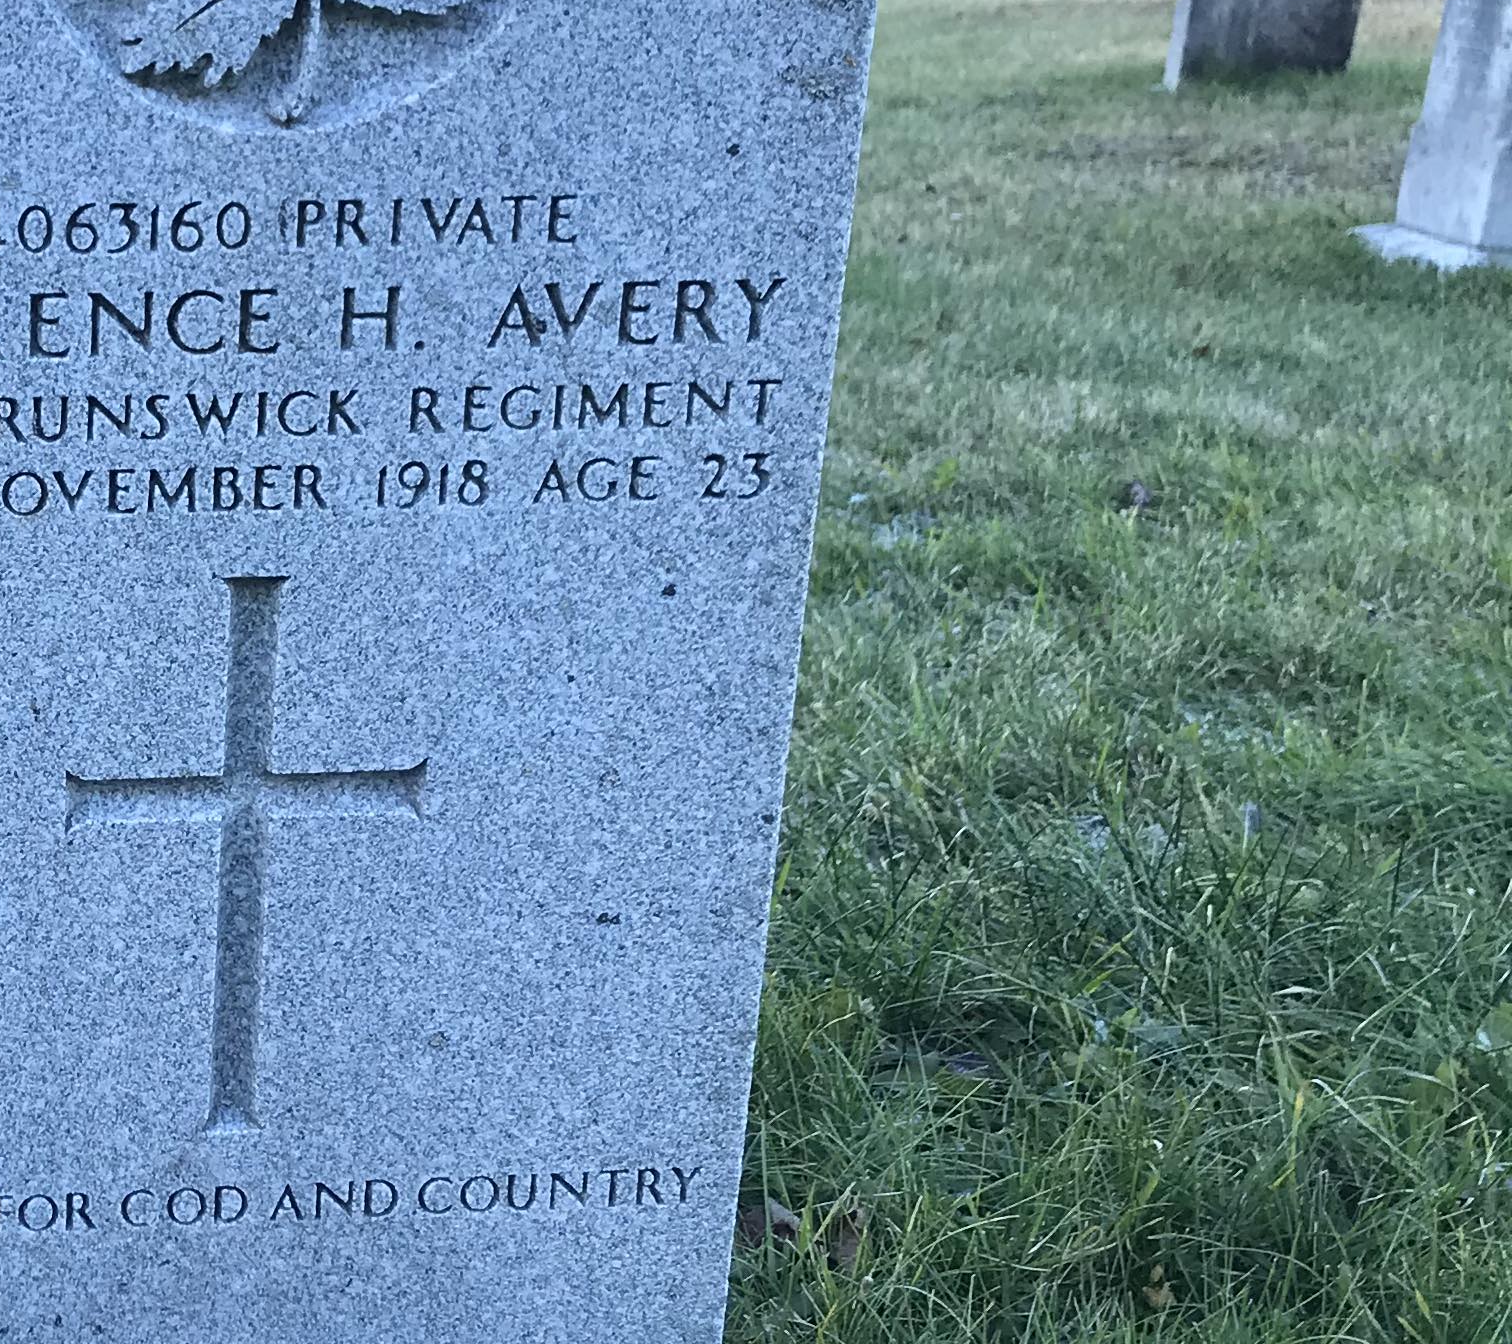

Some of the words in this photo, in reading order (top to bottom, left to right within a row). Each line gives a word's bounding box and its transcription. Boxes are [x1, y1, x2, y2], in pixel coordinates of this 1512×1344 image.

[295, 194, 578, 248] PRIVATE
[340, 285, 426, 350] H.
[487, 277, 787, 348] AVERY
[409, 379, 783, 433] REGIMENT
[377, 459, 488, 508] 1918
[533, 456, 664, 504] AGE
[701, 452, 772, 500] 23
[270, 1178, 399, 1221] AND
[418, 1166, 702, 1214] COUNTRY
